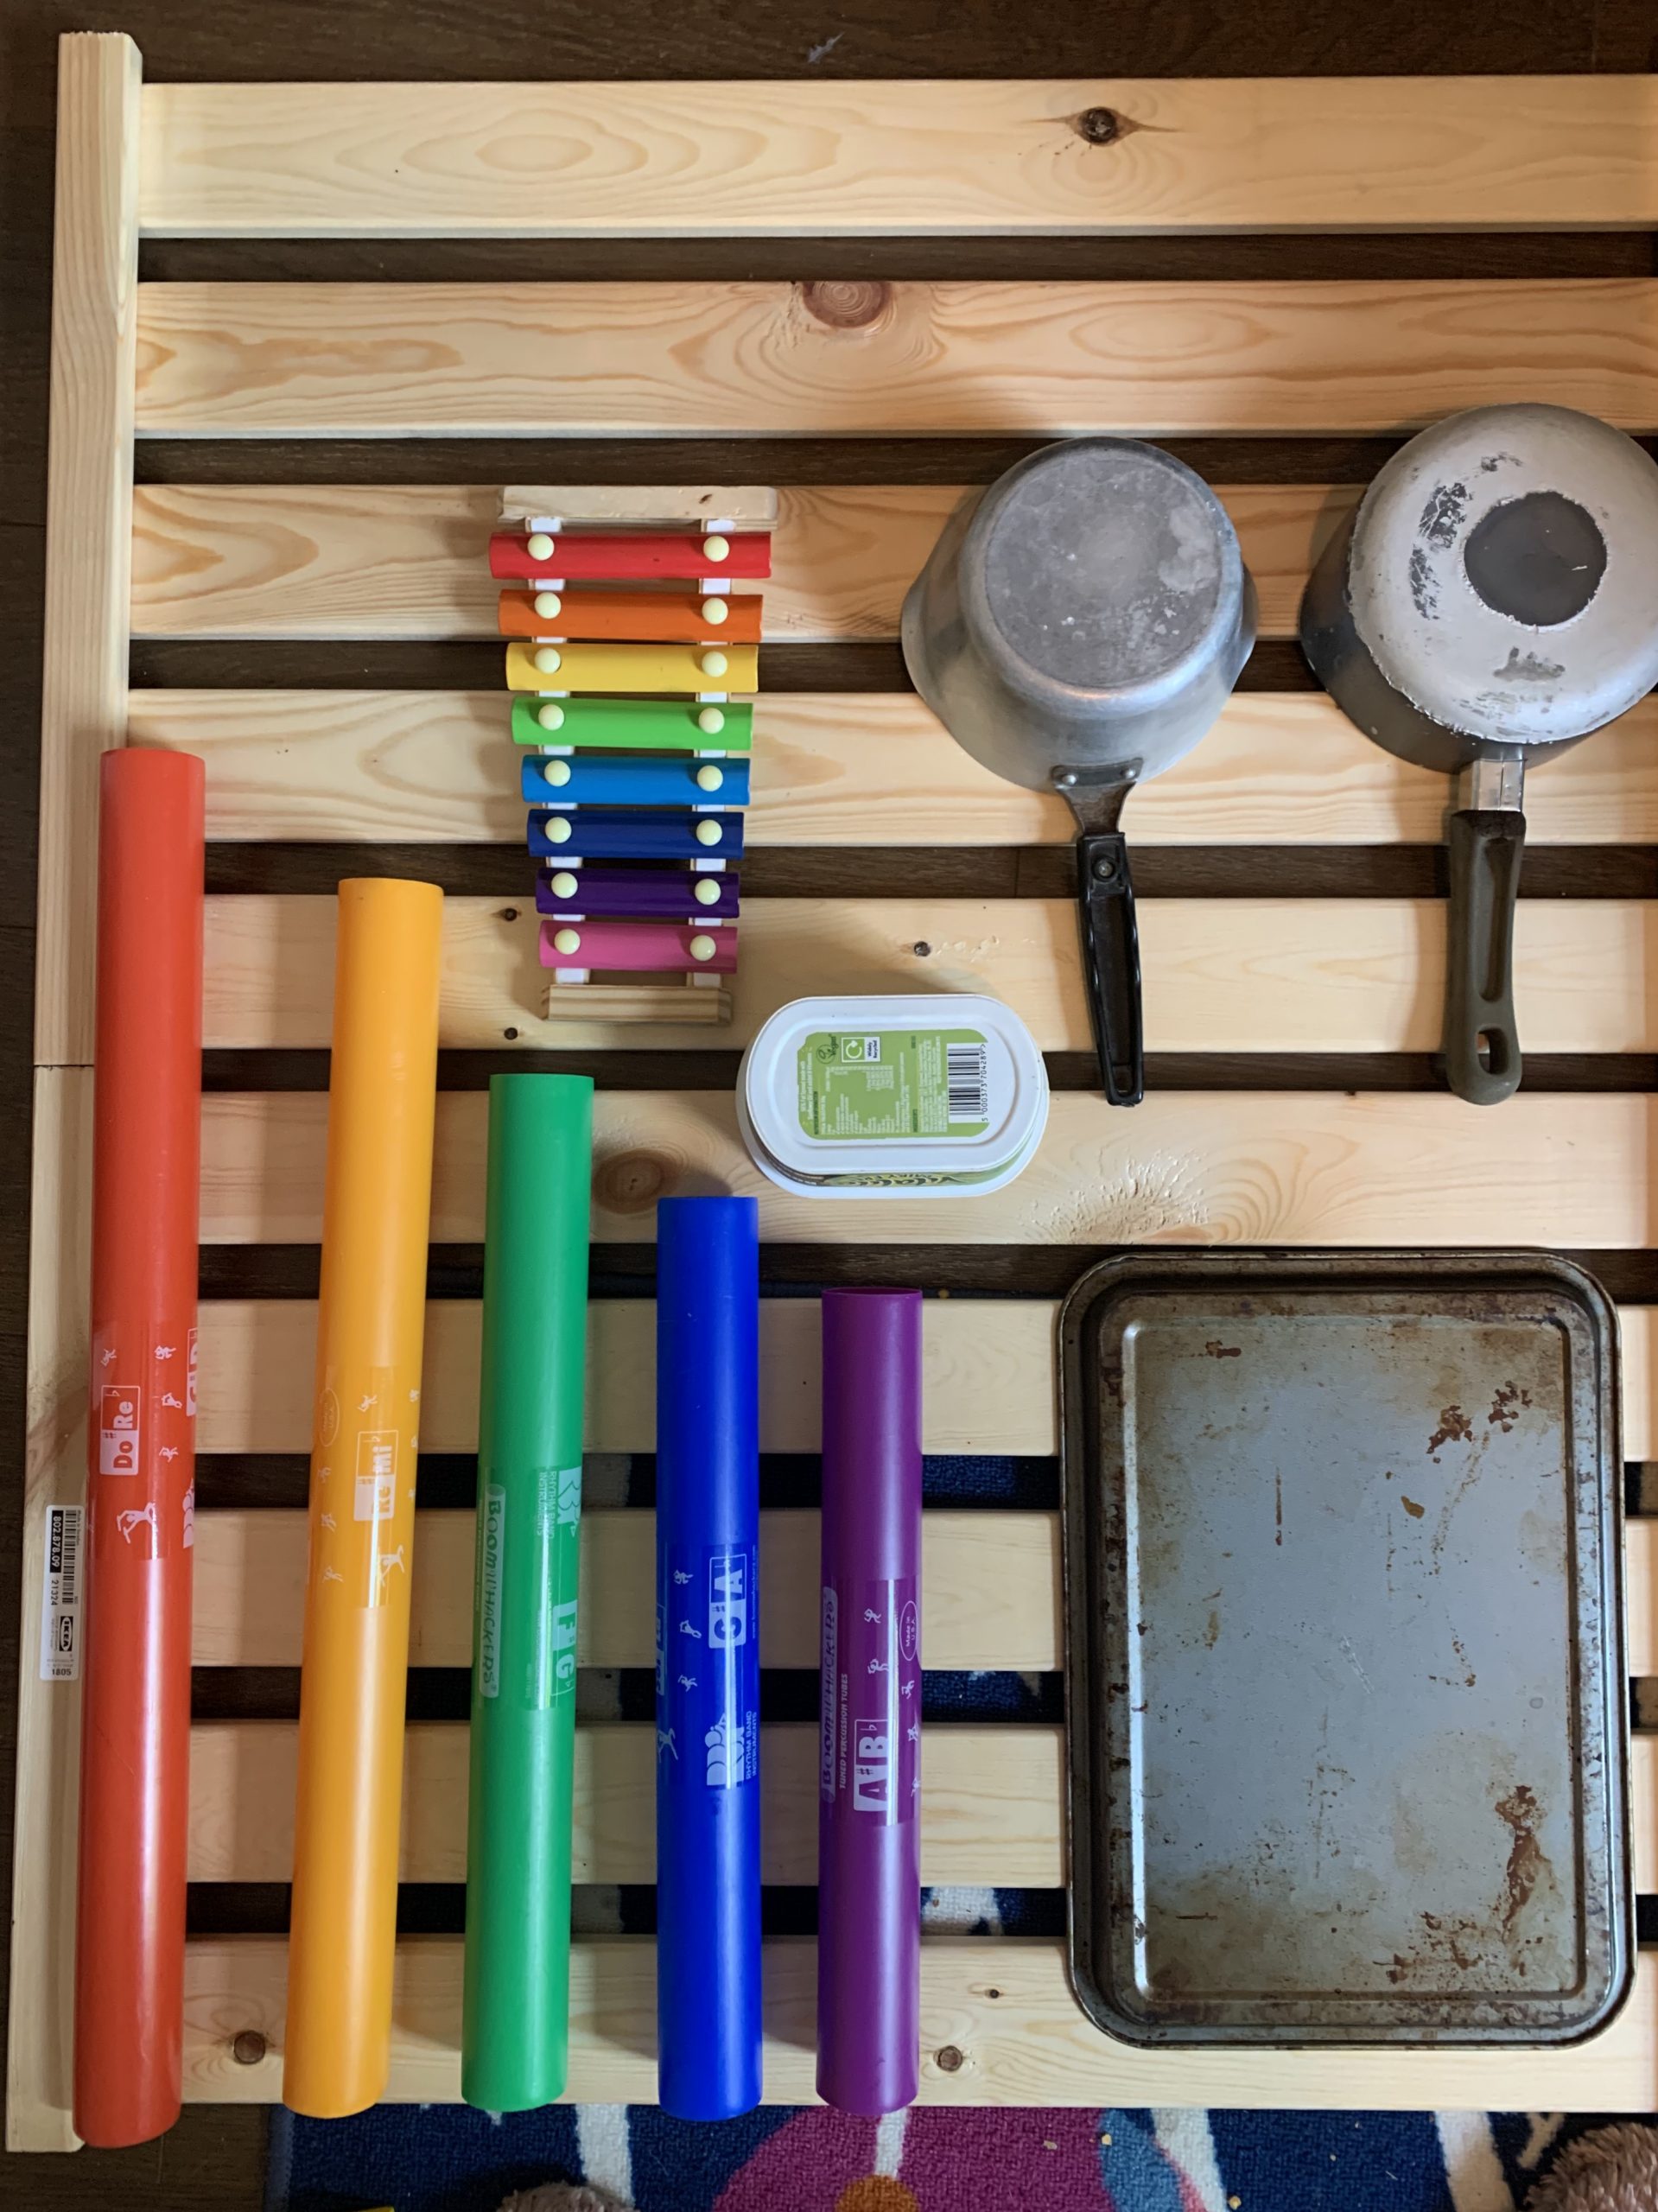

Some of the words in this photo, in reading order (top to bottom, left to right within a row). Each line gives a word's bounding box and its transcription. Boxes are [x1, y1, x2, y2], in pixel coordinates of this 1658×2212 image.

[828, 1036, 838, 1057] Vegan
[537, 1471, 548, 1537] INSTRUMENTS
[548, 1471, 556, 1510] RHYTHM
[52, 1516, 61, 1567] 802.878.09
[840, 1704, 848, 1758] PERCUSSION
[839, 1760, 848, 1789] TUNED
